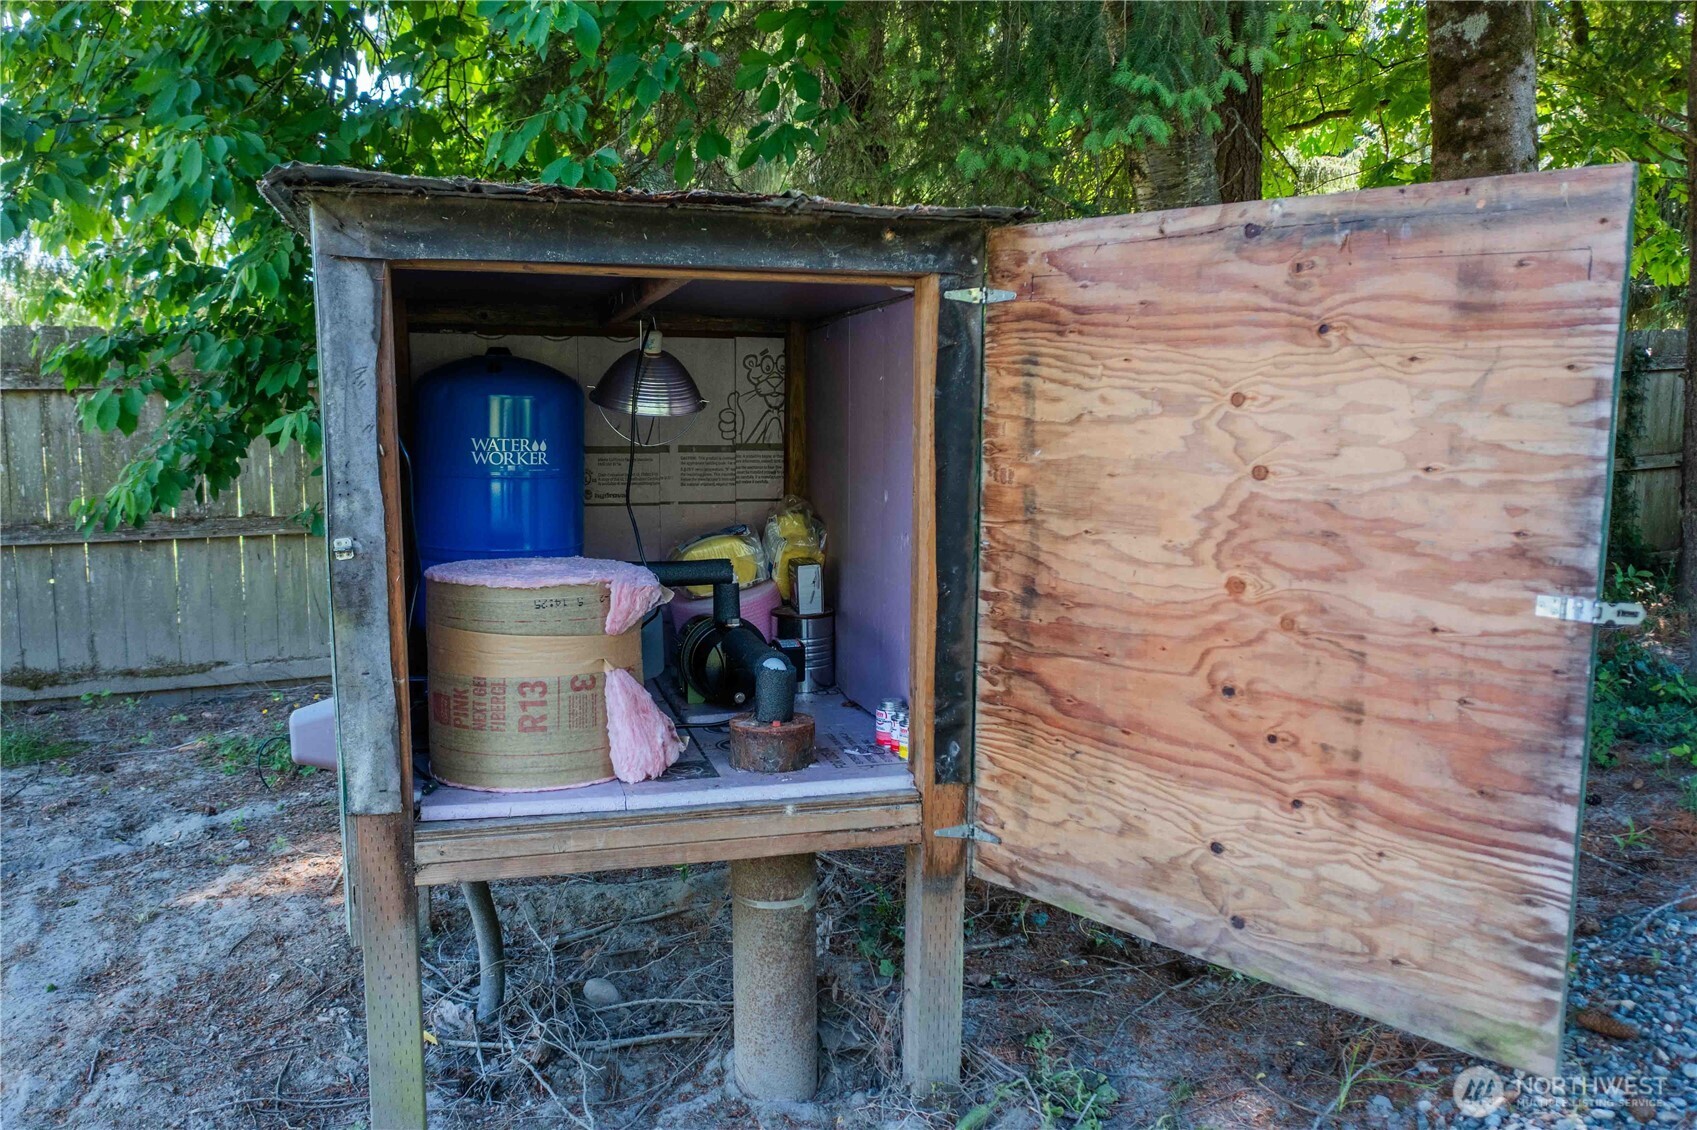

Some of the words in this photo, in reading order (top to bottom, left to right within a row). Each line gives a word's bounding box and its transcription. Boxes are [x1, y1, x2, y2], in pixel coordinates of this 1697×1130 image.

[471, 438, 532, 452] WATER
[471, 451, 549, 465] WORKER
[453, 687, 470, 731] PINK
[472, 700, 487, 732] NEXT
[490, 677, 507, 733] FIBERGL
[517, 680, 548, 733] R13
